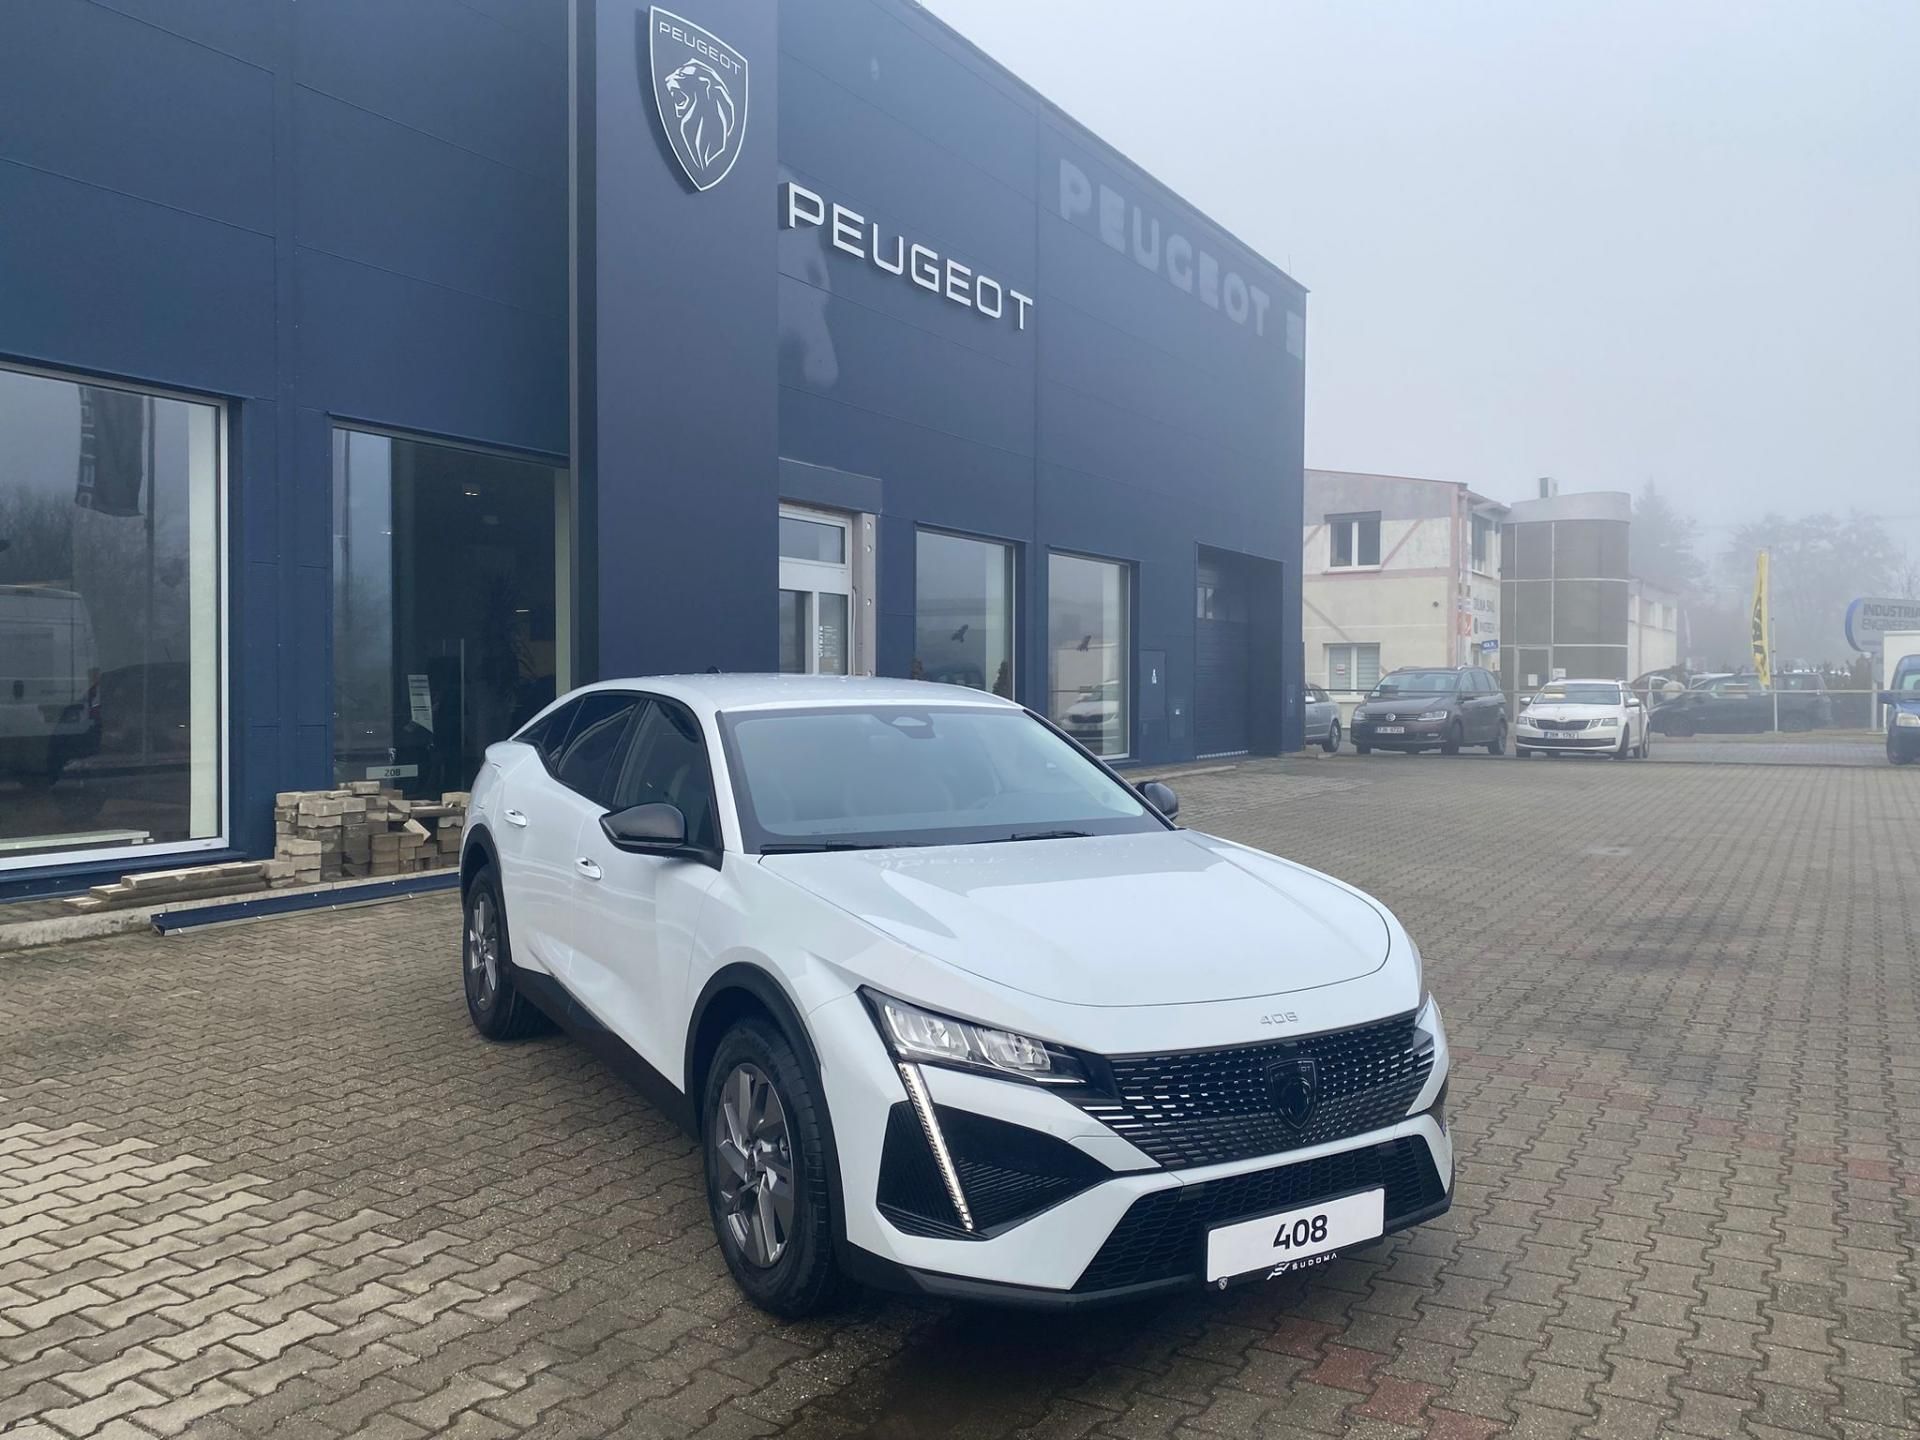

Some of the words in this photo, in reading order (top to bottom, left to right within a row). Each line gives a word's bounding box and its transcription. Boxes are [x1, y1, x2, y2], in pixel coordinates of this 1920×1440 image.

[659, 21, 741, 75] PEUGEOT
[788, 181, 1033, 330] PEUGEOT
[1273, 1214, 1328, 1250] 408
[1292, 1252, 1337, 1270] SUDOMA
